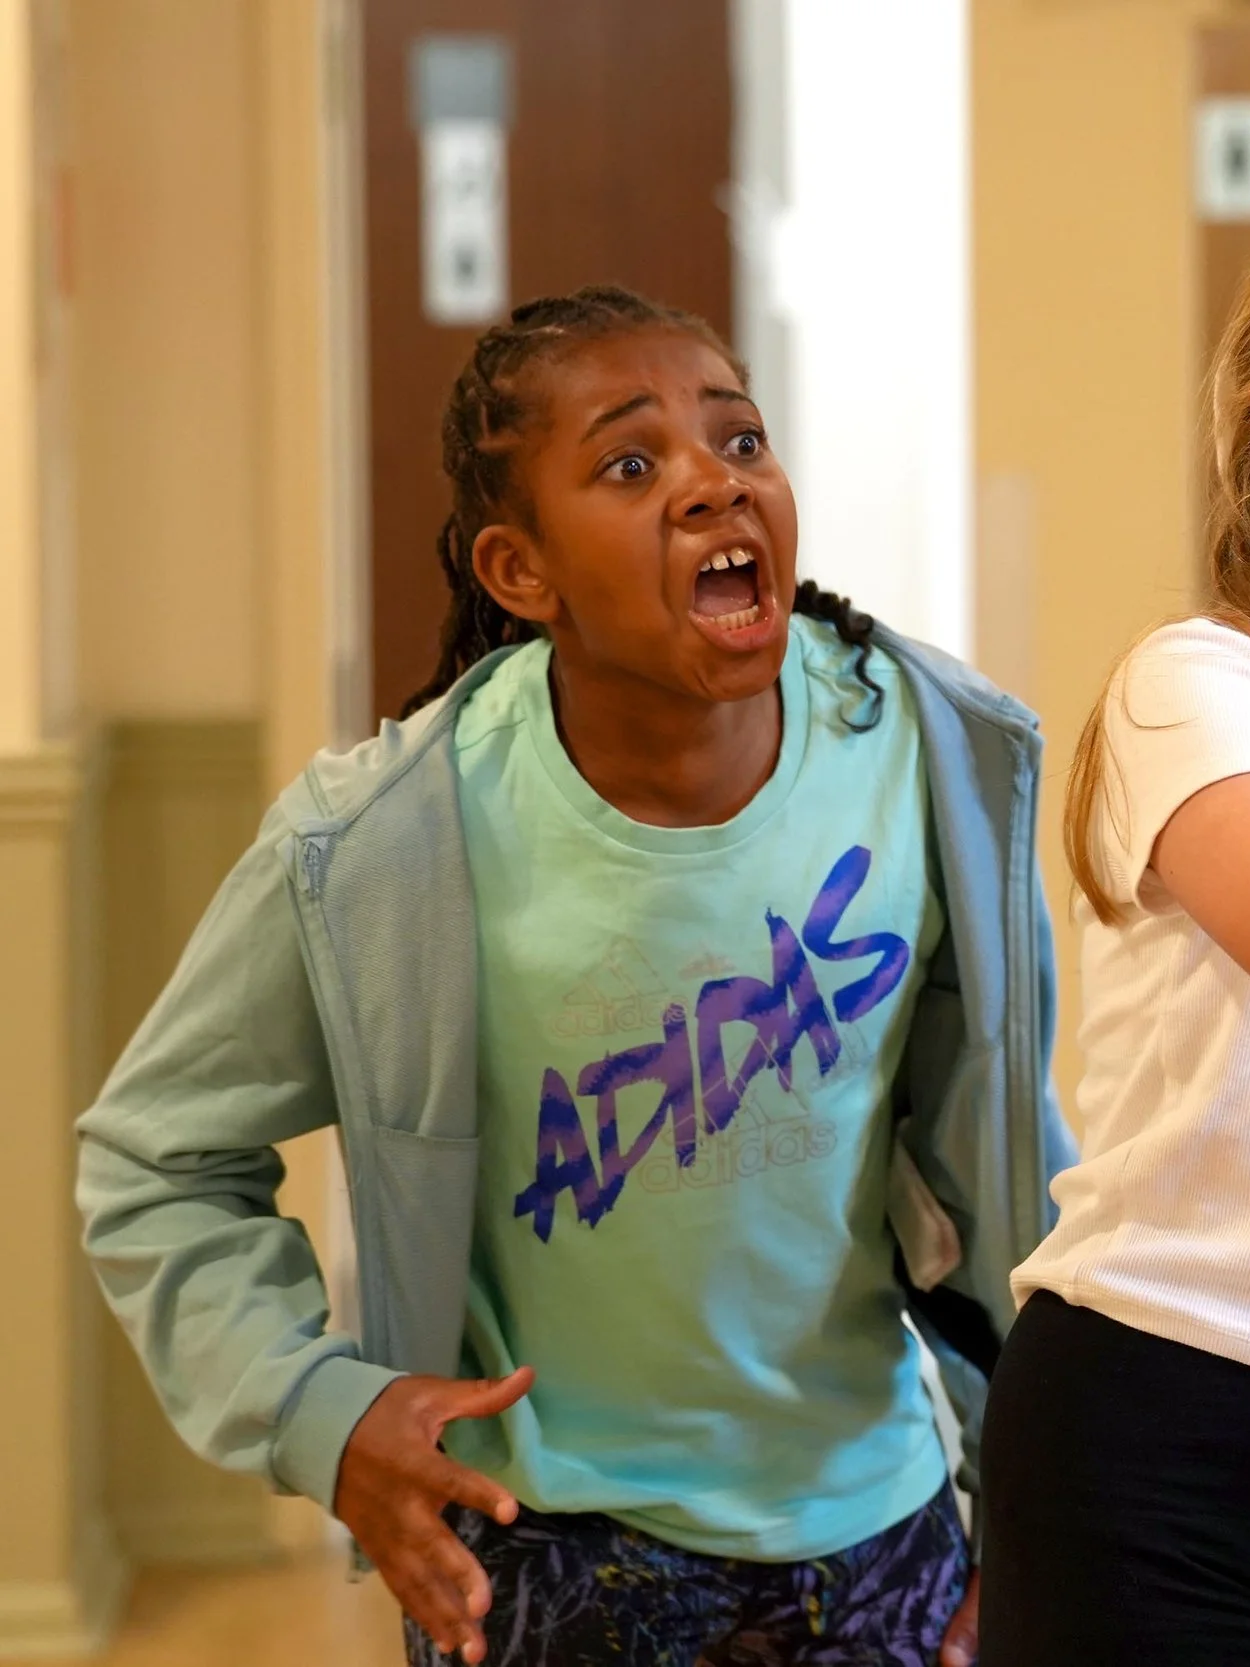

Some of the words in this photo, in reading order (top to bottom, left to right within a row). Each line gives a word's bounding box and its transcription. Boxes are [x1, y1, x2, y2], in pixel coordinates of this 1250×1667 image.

[514, 844, 910, 1244] ADIDAS
[552, 994, 689, 1038] adidas
[637, 1120, 837, 1194] adidas
